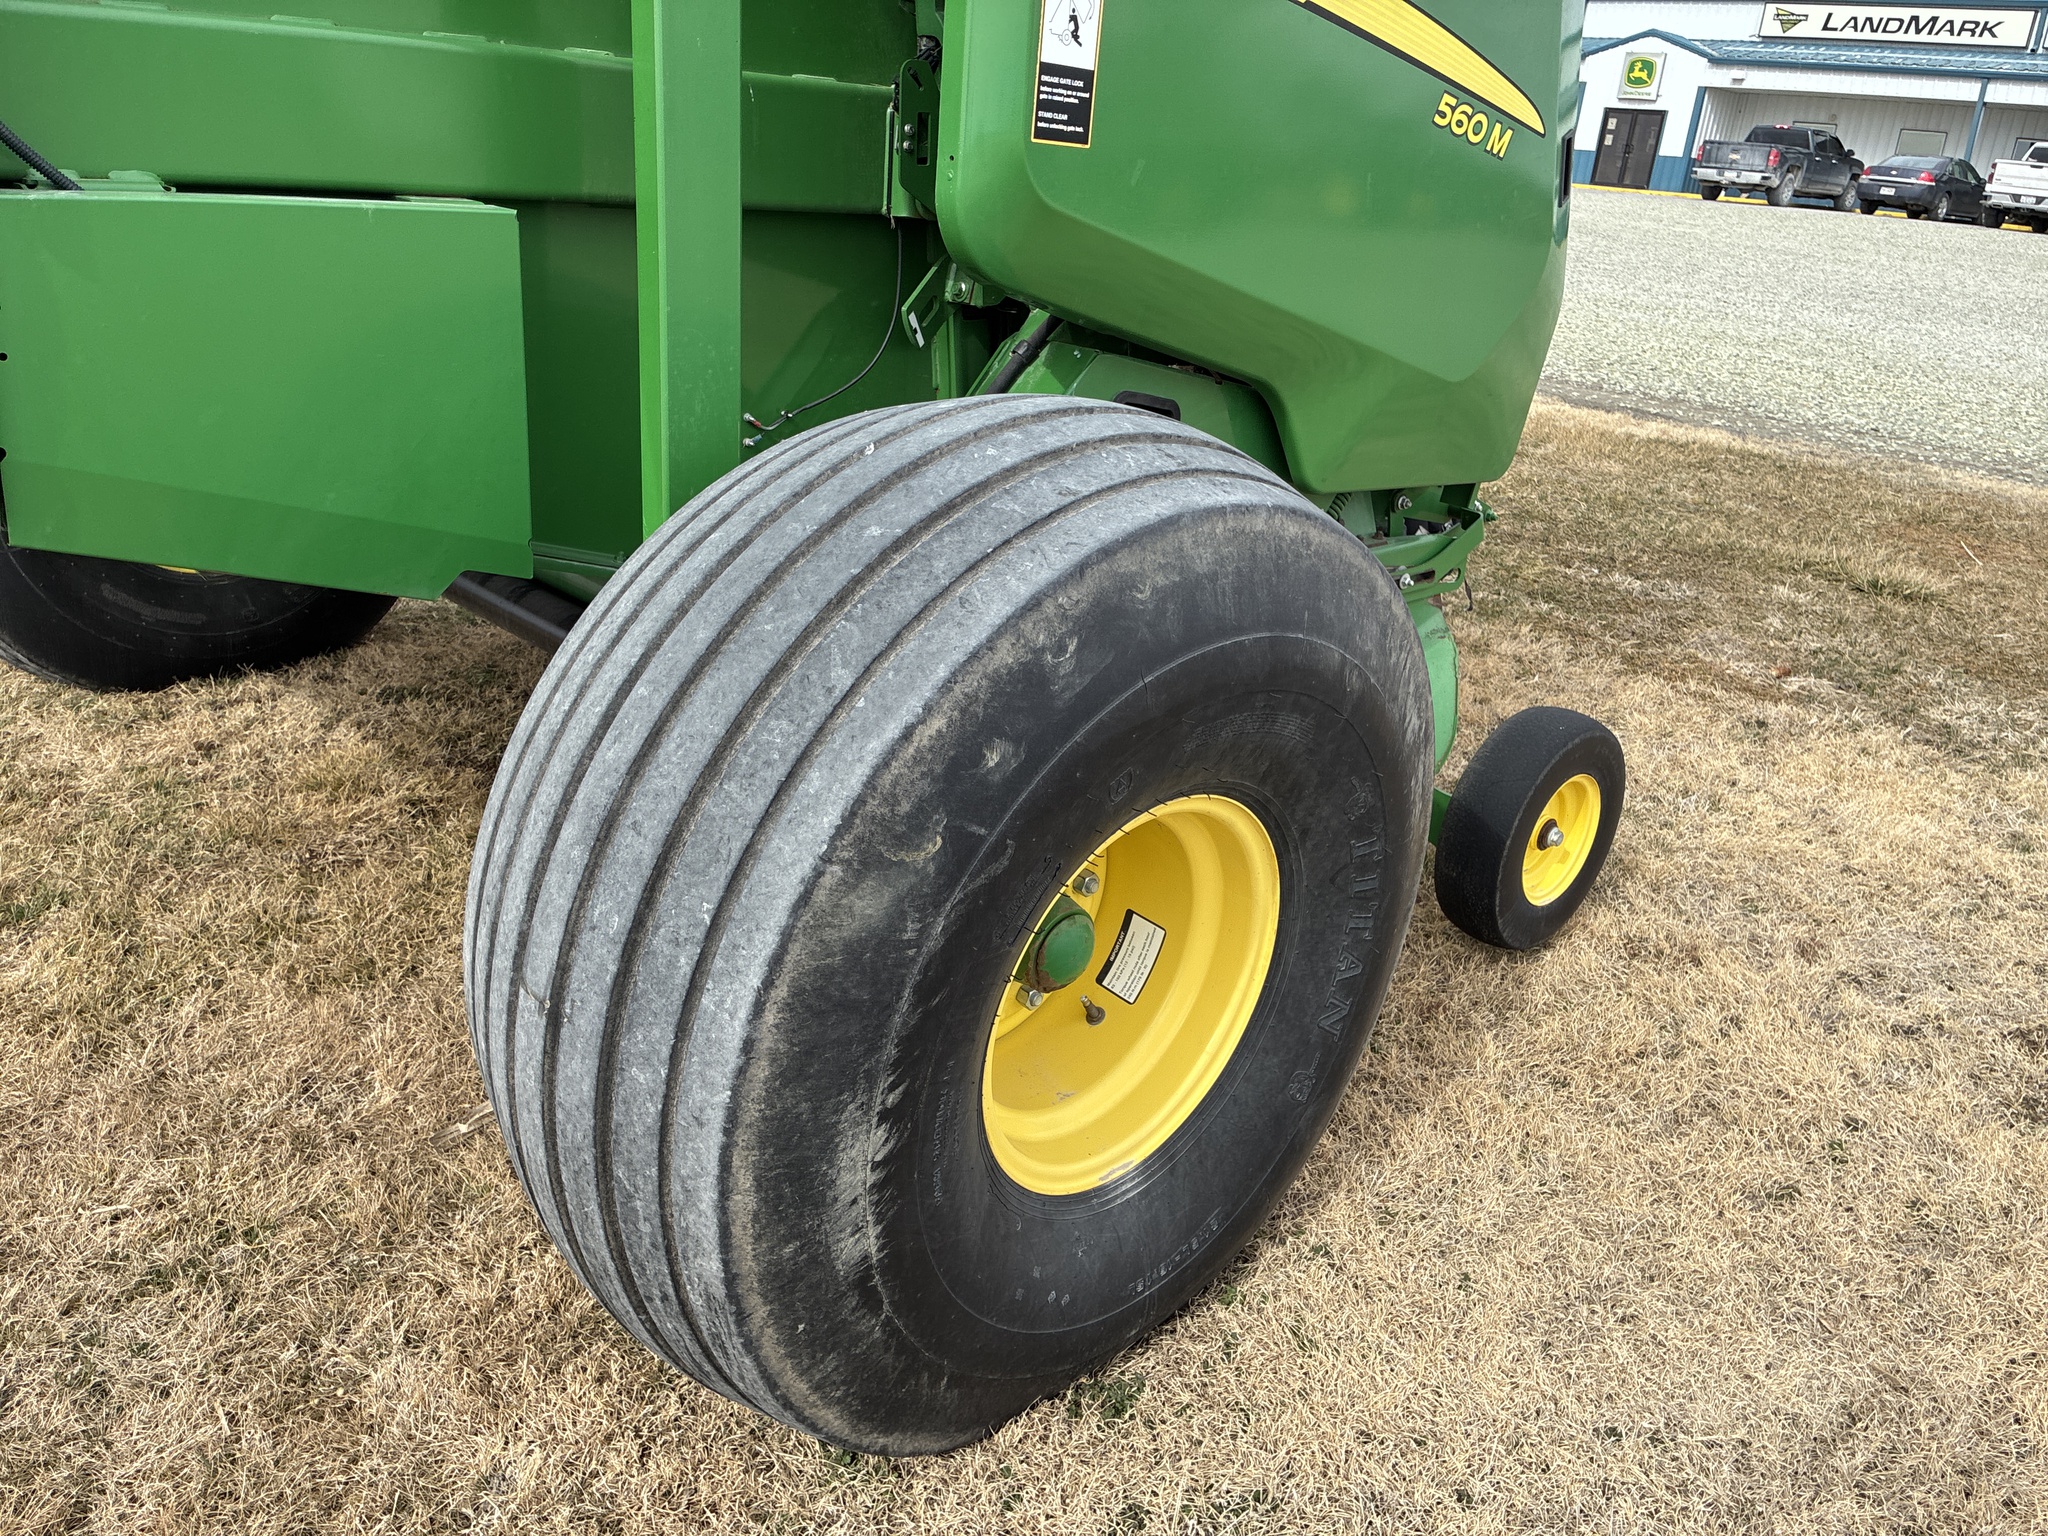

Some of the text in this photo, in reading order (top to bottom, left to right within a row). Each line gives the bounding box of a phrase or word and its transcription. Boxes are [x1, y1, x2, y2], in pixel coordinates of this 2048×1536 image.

[1041, 75, 1059, 83] ENGAGE
[1060, 77, 1071, 85] GATE
[1038, 110, 1053, 118] STAND
[1432, 90, 1515, 161] 560 M
[1108, 930, 1125, 961] IMPORTANT
[1315, 823, 1386, 1042] TITAN
